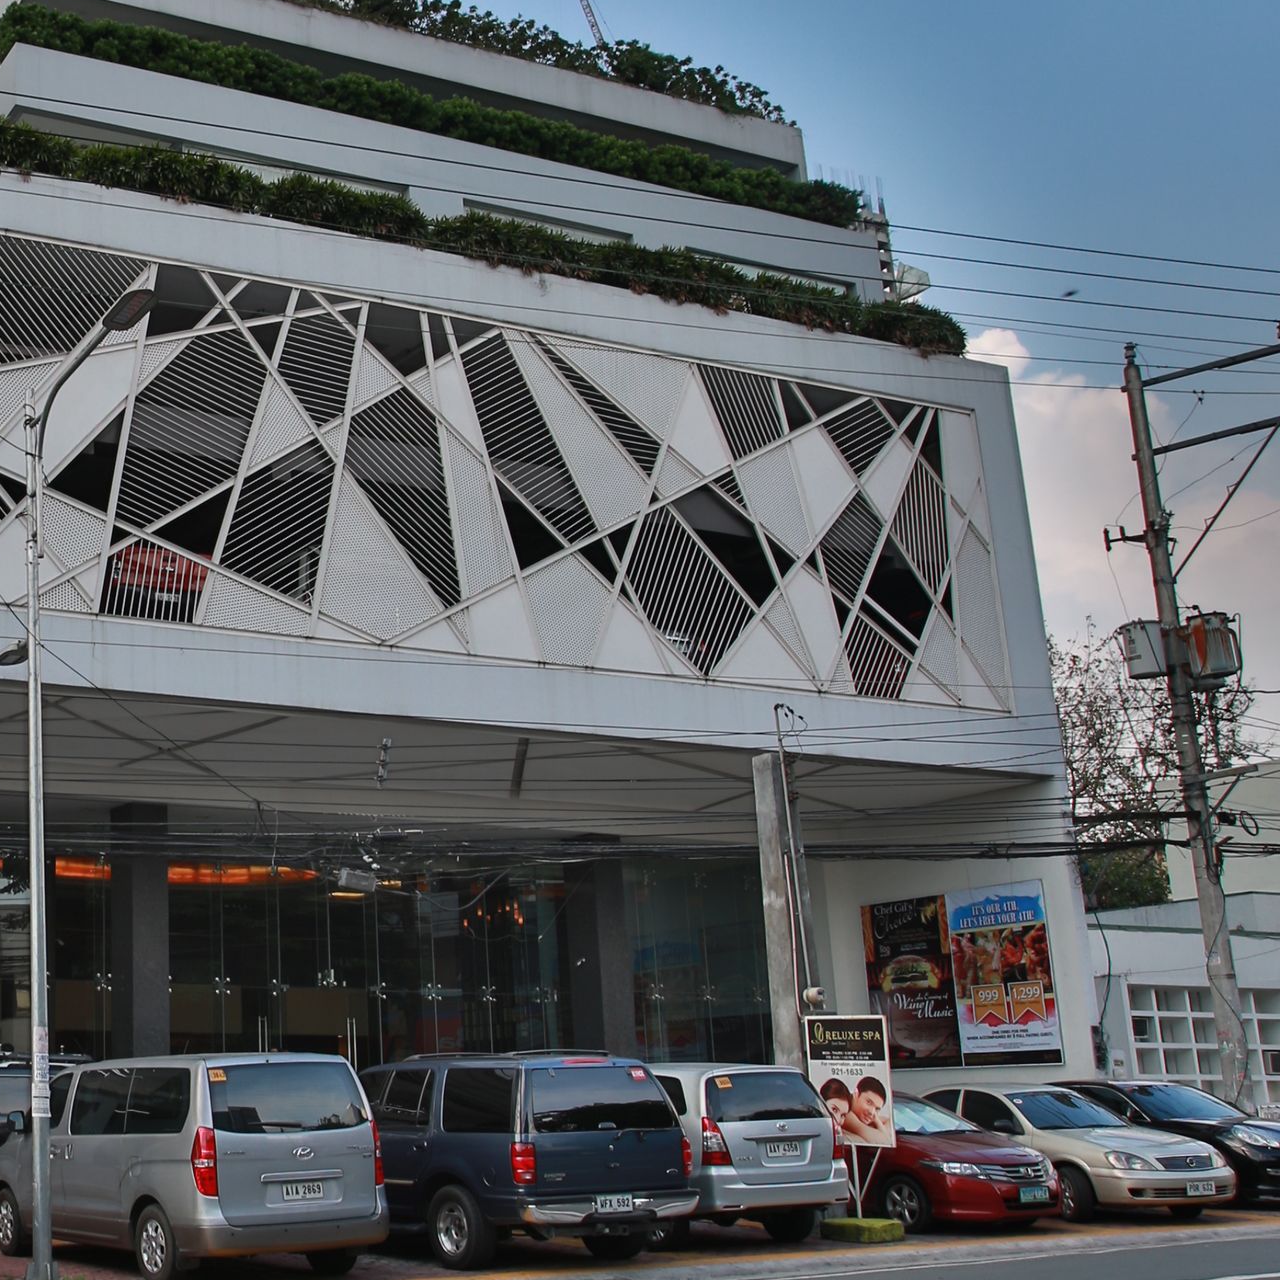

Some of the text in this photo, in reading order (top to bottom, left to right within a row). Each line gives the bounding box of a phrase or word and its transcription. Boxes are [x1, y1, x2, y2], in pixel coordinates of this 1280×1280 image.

[874, 905, 894, 916] Chef
[986, 903, 1001, 914] OUR
[978, 915, 996, 927] FREE
[996, 912, 1017, 924] YOUR
[978, 986, 1040, 1002] 999 1,299
[893, 992, 926, 1010] Wine
[917, 1000, 954, 1019] Music
[825, 1031, 881, 1040] RELUXE SPA
[831, 1068, 864, 1076] 921-1633
[302, 1183, 322, 1195] 2869
